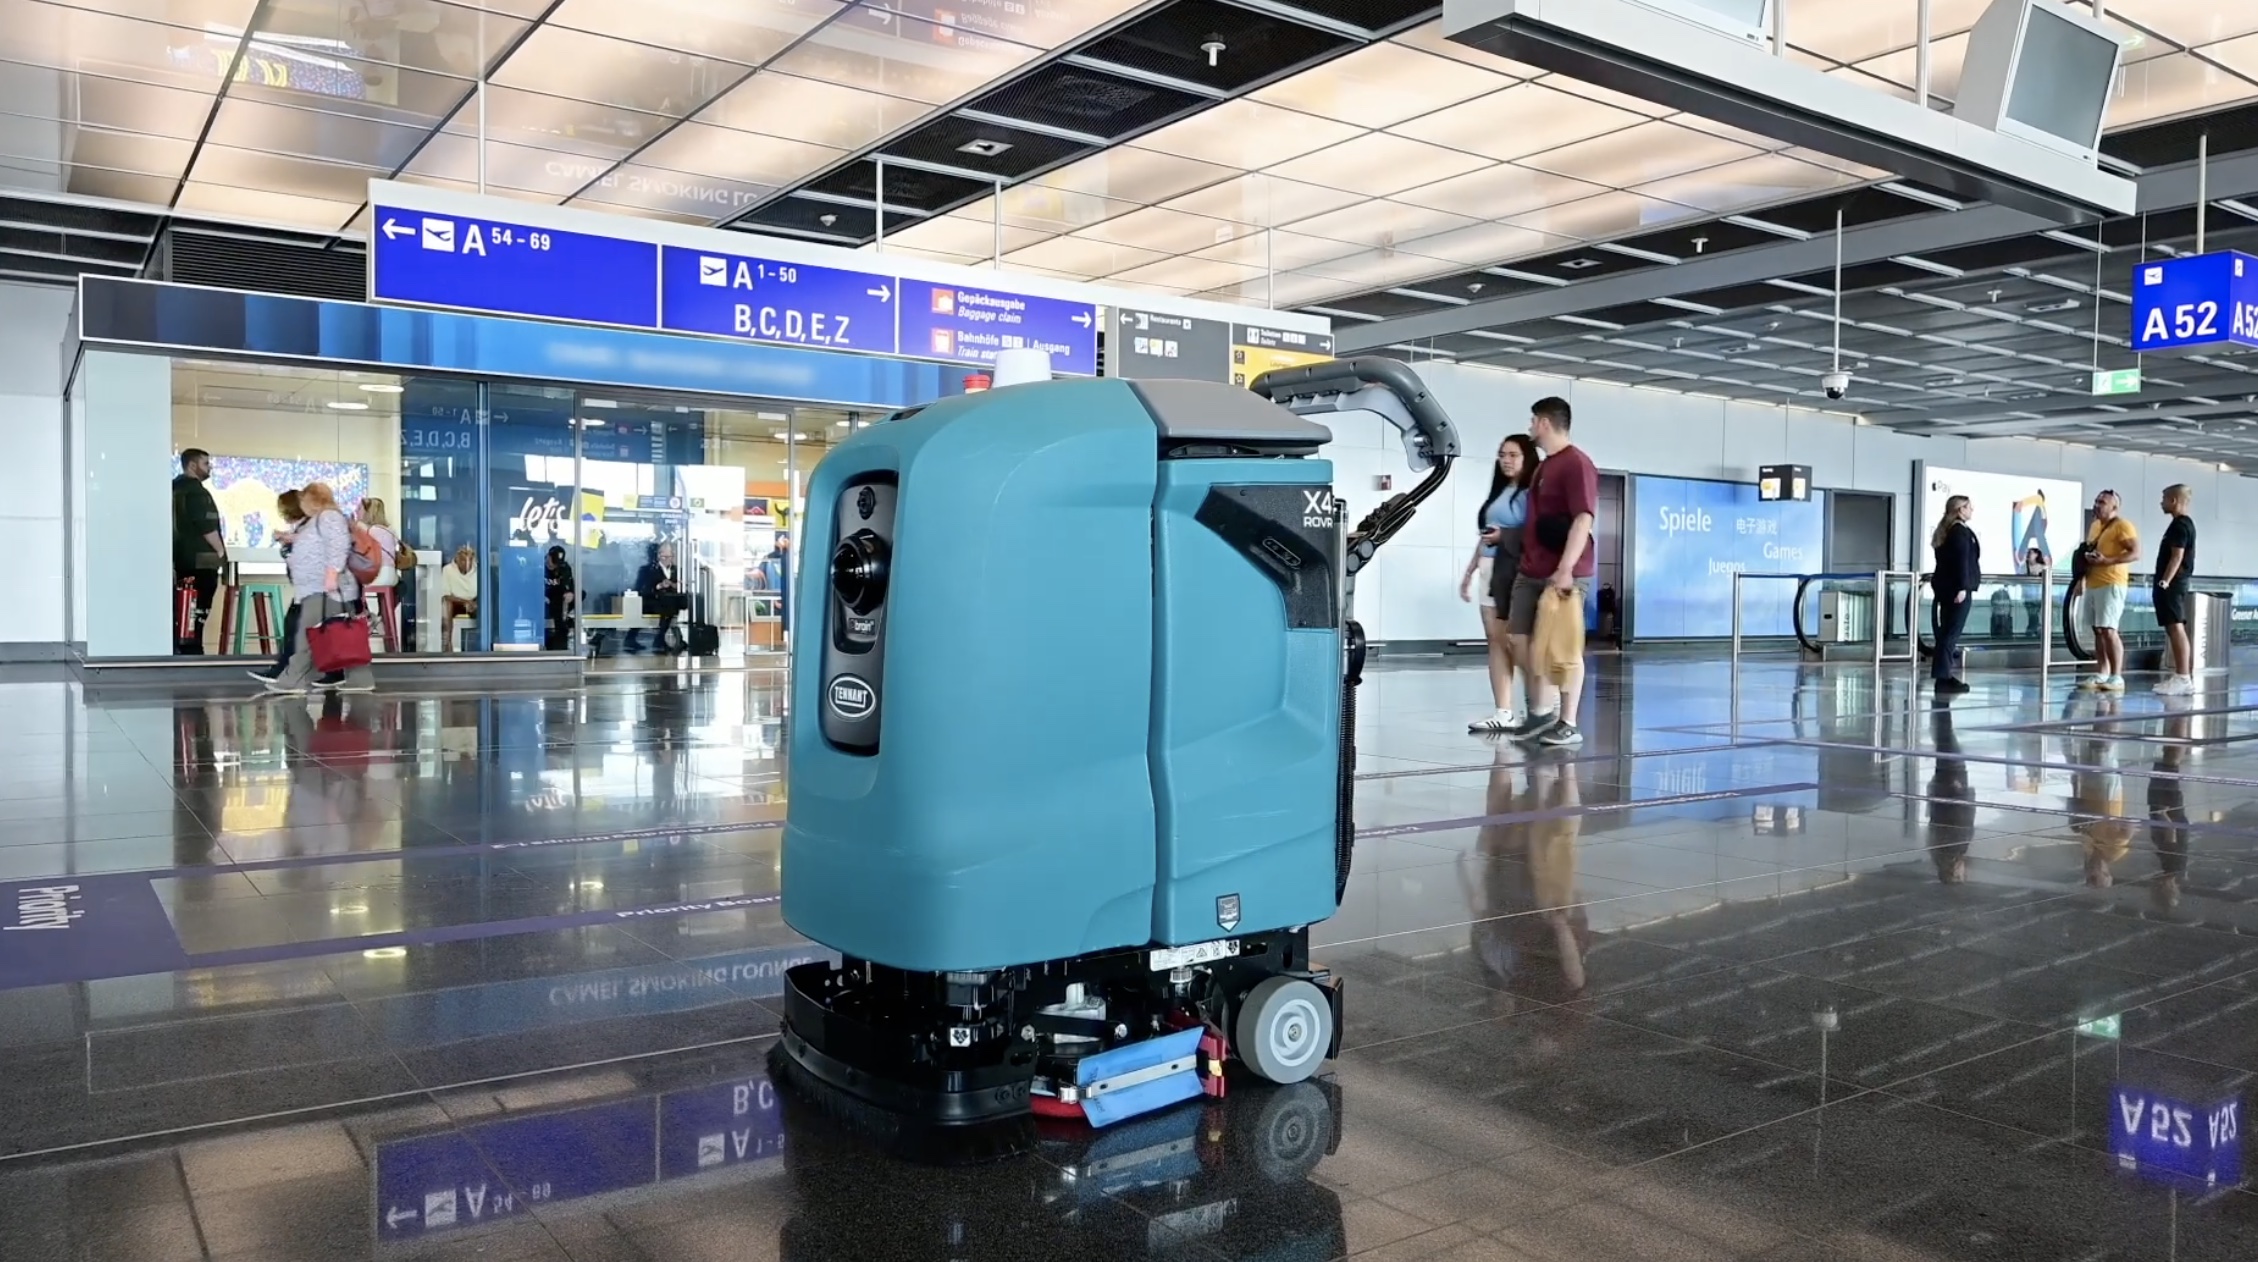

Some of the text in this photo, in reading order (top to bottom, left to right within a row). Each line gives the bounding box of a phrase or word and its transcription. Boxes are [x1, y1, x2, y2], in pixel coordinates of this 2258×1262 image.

[462, 224, 487, 256] A
[491, 227, 513, 246] 54
[530, 232, 551, 251] 69
[733, 261, 753, 290] A
[757, 264, 764, 279] 1
[779, 266, 797, 283] 50
[957, 291, 1026, 311] Gepäckausgabe
[957, 306, 1022, 323] Baggage claim
[2141, 301, 2218, 342] A 52
[957, 330, 999, 346] Bahnhöfe
[1032, 339, 1071, 356] Ausgang
[957, 345, 979, 358] Train
[1303, 490, 1333, 515] X4
[1303, 516, 1334, 528] ROVR
[1659, 506, 1712, 538] Spiele
[1763, 542, 1803, 560] Games
[1708, 557, 1746, 577] Juegos
[835, 686, 868, 707] TENNANT
[3, 884, 85, 930] Priority
[616, 902, 713, 918] Priority
